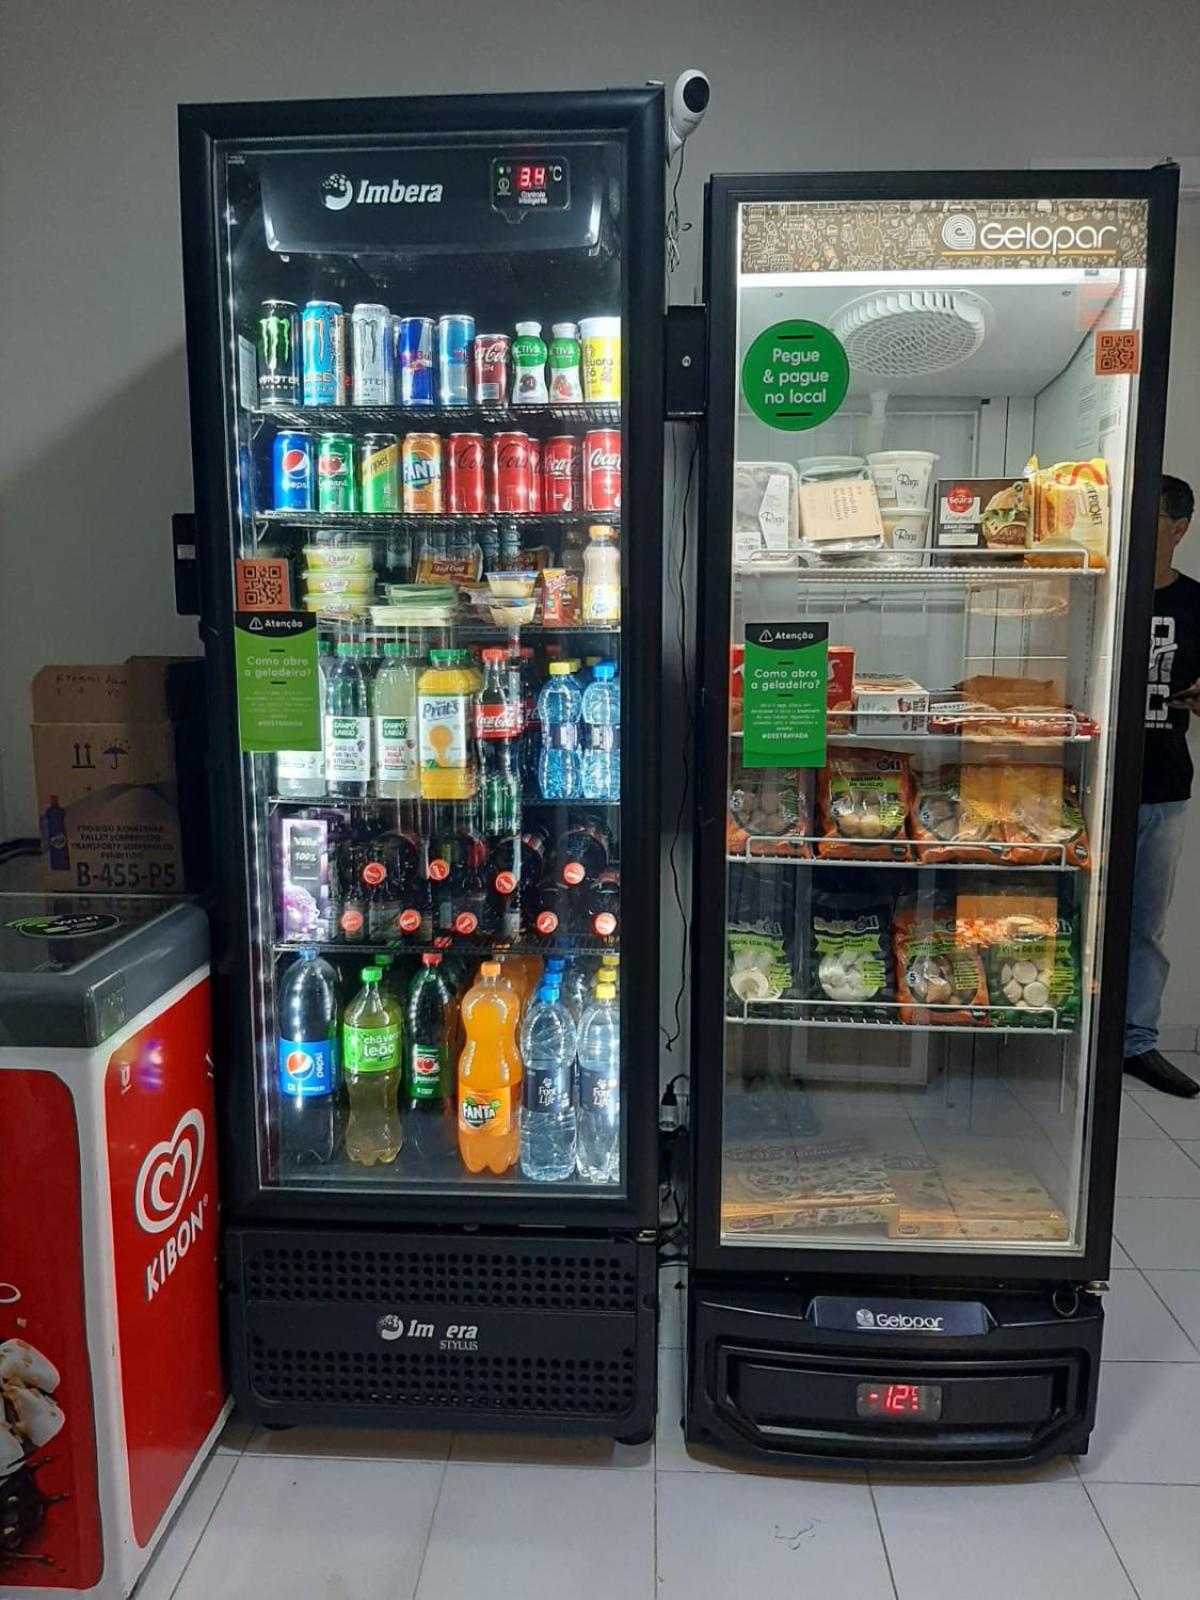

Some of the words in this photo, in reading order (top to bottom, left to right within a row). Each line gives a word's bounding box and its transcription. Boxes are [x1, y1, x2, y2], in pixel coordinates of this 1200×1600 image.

[356, 179, 443, 204] Imbera
[980, 222, 1117, 256] Gelopar
[772, 348, 821, 366] Pegue
[762, 369, 775, 384] &
[779, 370, 829, 387] pague
[765, 391, 784, 404] no
[790, 388, 827, 404] local
[265, 618, 303, 629] Atenção
[774, 631, 814, 641] Atenção
[246, 656, 280, 666] Como
[283, 656, 309, 666] abro
[244, 669, 251, 678] a
[255, 668, 312, 679] geladeira?
[754, 669, 788, 678] Como
[791, 669, 818, 678] abro
[751, 682, 758, 690] a
[762, 680, 821, 691] geladeira?
[77, 862, 176, 888] B-455-P5
[462, 1103, 496, 1120] FANTA
[146, 1200, 204, 1301] KIBON
[407, 1319, 478, 1339] Imera
[876, 1313, 944, 1329] Gelopar
